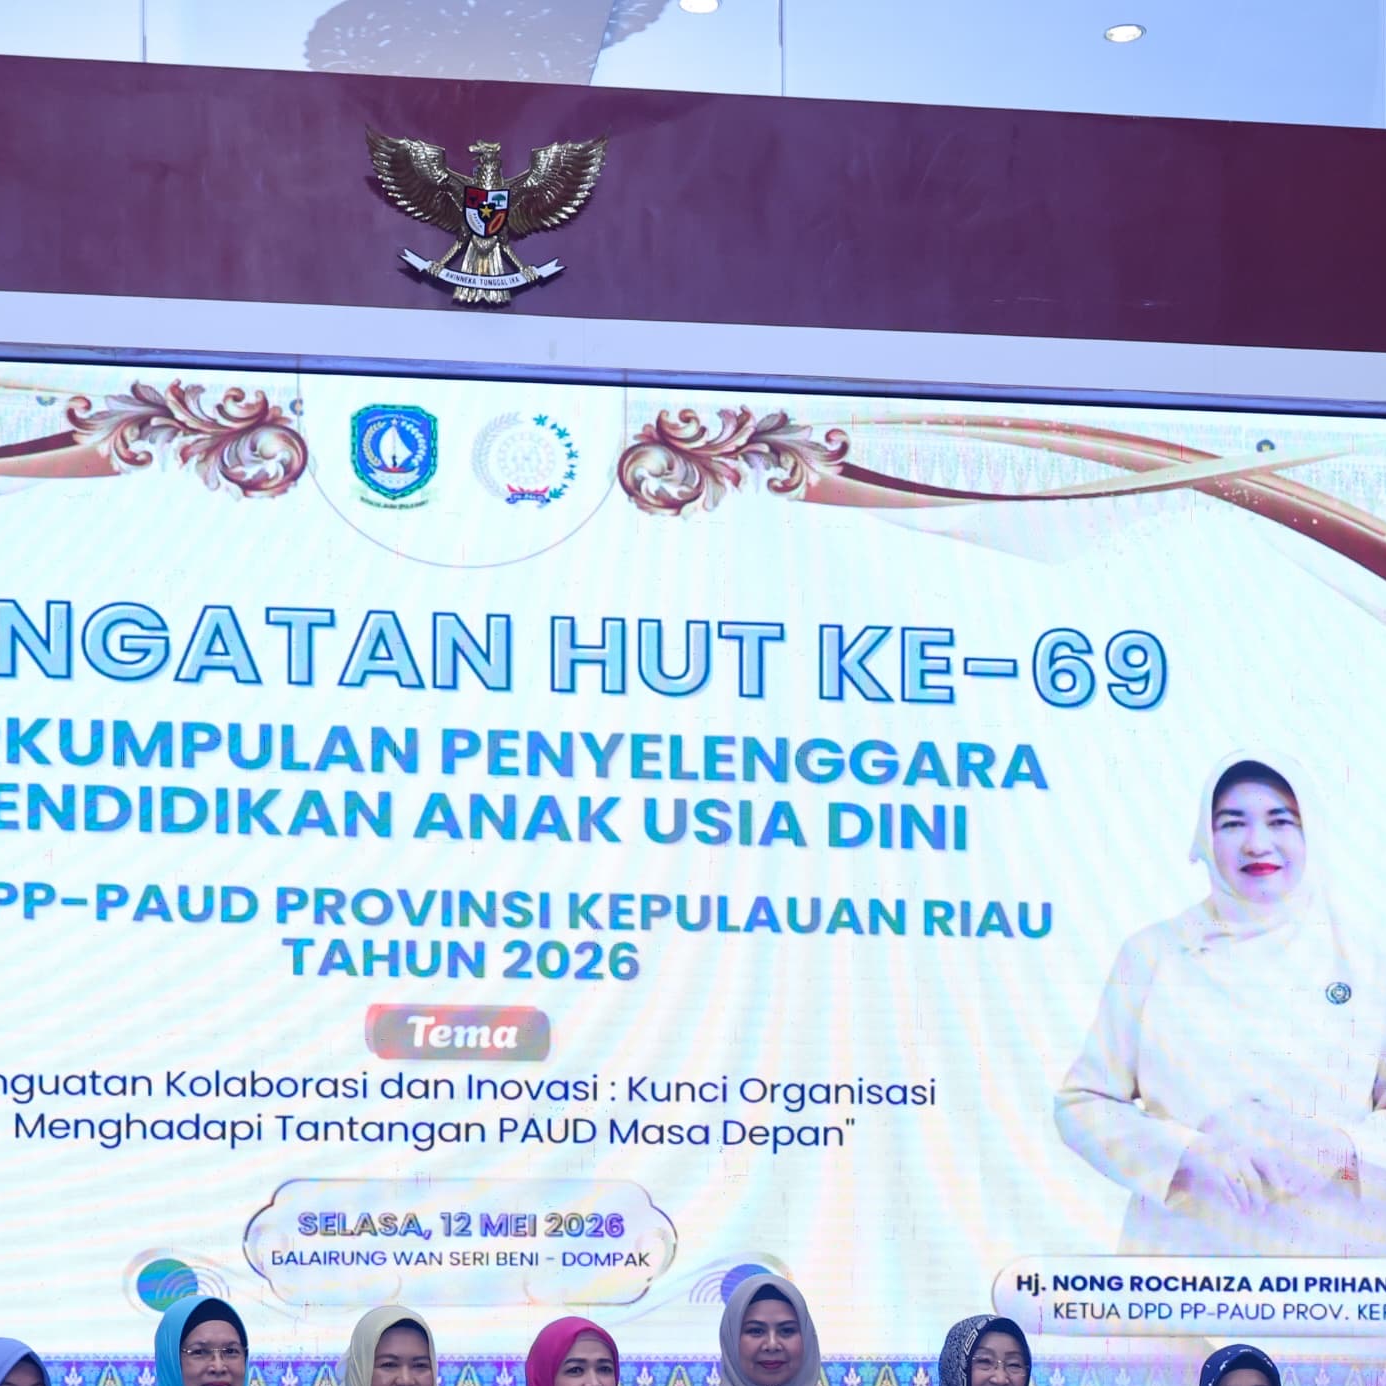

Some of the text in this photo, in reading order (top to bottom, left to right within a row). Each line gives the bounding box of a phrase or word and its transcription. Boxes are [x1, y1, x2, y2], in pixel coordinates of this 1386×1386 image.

[549, 615, 785, 699] HUT
[818, 623, 1169, 709] KE-69
[440, 727, 1049, 789] PENYELENGGARA
[413, 792, 622, 842] ANAK
[644, 797, 807, 847] USIA
[828, 802, 967, 850] DINI
[276, 886, 551, 928] PROVINSI
[568, 892, 907, 936] KEPULAUAN
[923, 899, 1052, 939] RIAU
[281, 937, 640, 981] TAHUN 2026
[406, 1016, 519, 1049] Tema
[165, 1069, 368, 1099] Kolaborasi
[380, 1071, 454, 1100] dan
[466, 1074, 599, 1102] Inovasi
[628, 1075, 728, 1104] Kunci
[739, 1077, 937, 1113] Organisasi
[14, 1112, 856, 1154] Menghadapi Tantangan PAUD Masa Depan"
[297, 1212, 626, 1240] SELASA, 12 MEI 2026
[271, 1250, 388, 1267] BALAIRUNG
[392, 1251, 445, 1267] WAN
[449, 1251, 490, 1267] SERI
[496, 1251, 539, 1267] BENI
[562, 1252, 651, 1267] DOMPAK
[1016, 1274, 1047, 1297] Hj.
[1052, 1275, 1124, 1292] NONG
[1130, 1275, 1254, 1292] ROCHAIZA
[1259, 1276, 1298, 1293] ADI
[1053, 1302, 1121, 1319] KETUA
[1128, 1303, 1173, 1320] DPD
[1180, 1303, 1276, 1321] PP-PAUD
[1283, 1304, 1350, 1321] PROV.
